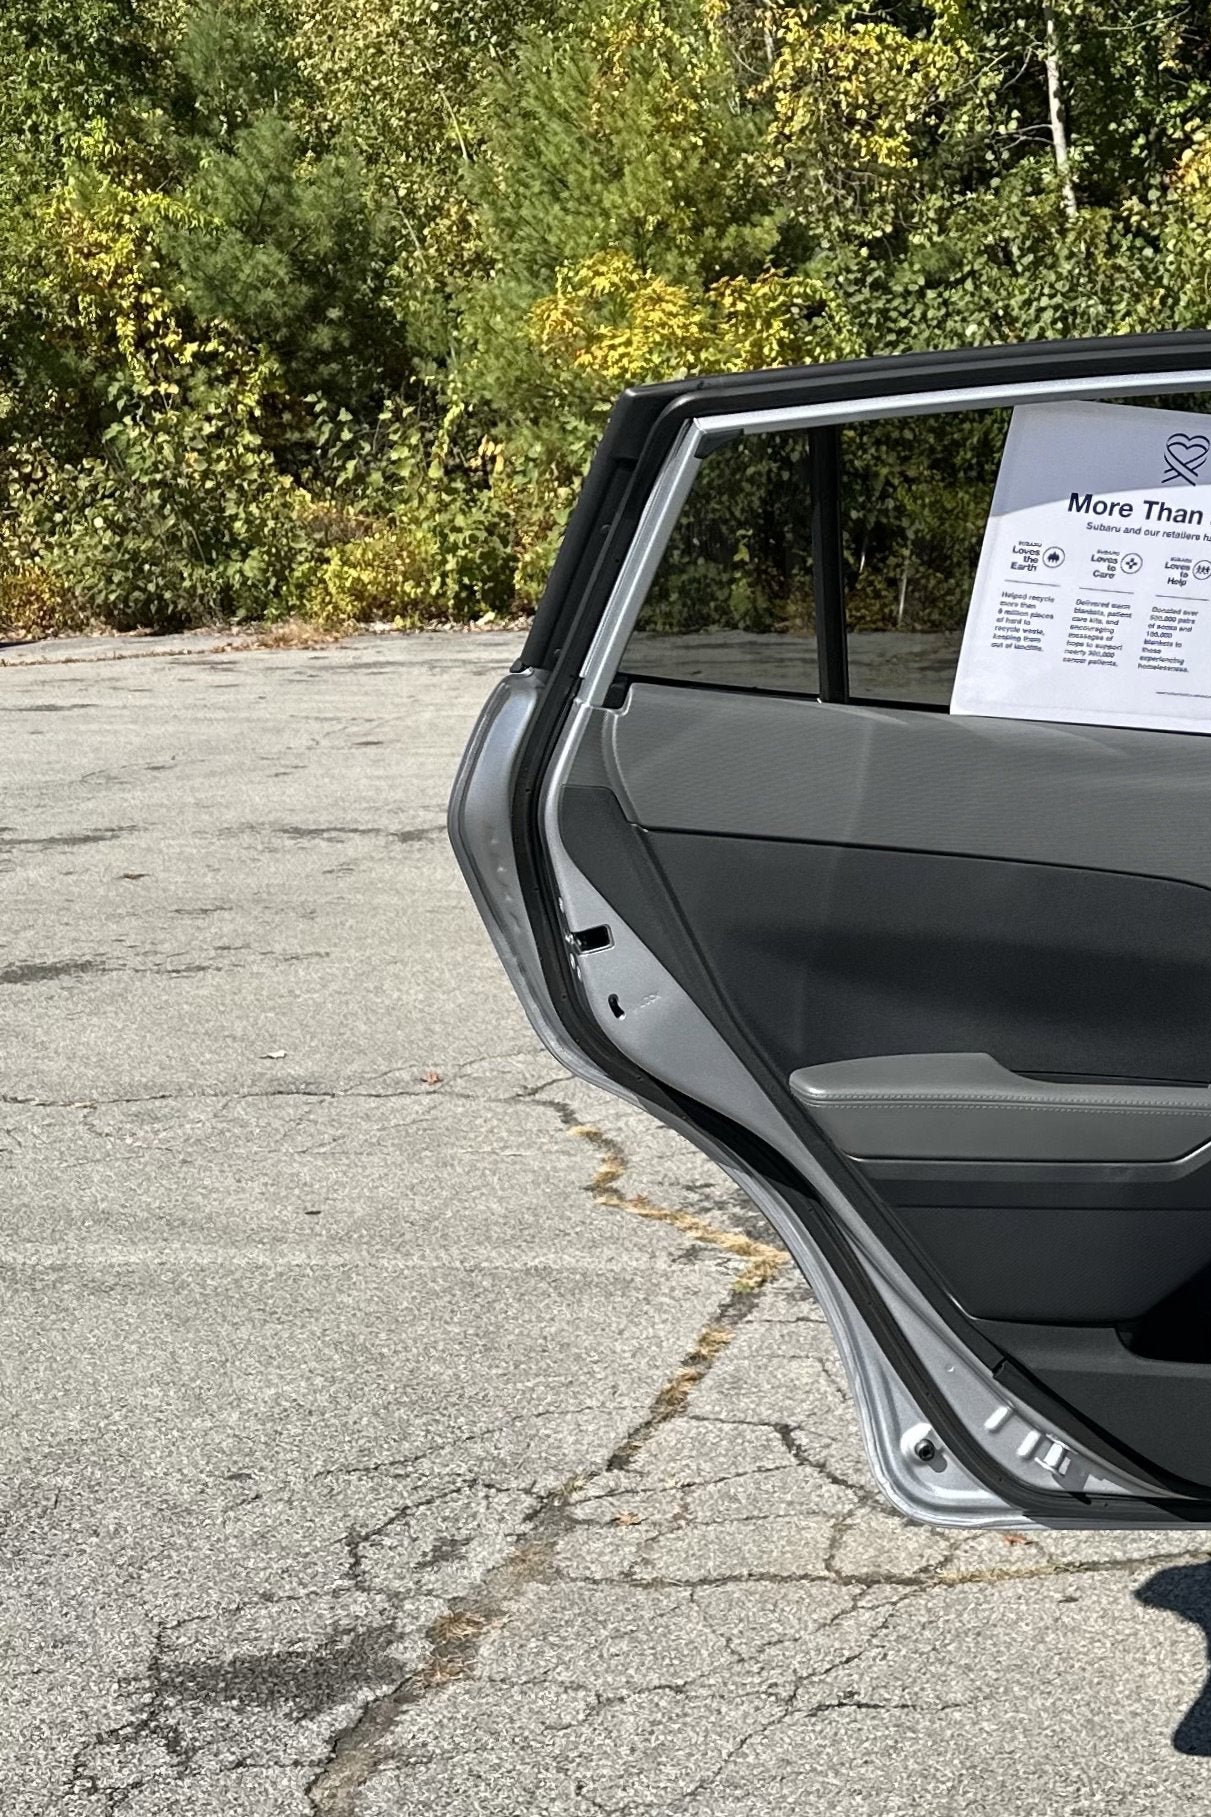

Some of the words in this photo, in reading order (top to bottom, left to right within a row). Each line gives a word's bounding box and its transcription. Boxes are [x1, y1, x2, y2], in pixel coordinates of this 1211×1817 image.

[1068, 492, 1134, 518] More
[1143, 500, 1203, 525] Than
[1086, 522, 1120, 533] Subaru
[1123, 524, 1141, 535] and
[1144, 528, 1160, 537] our
[1162, 529, 1200, 540] retailers
[1012, 546, 1040, 556] Loves
[1023, 555, 1039, 564] the
[1091, 554, 1118, 564] Loves
[1011, 562, 1037, 572] Earth
[1107, 564, 1116, 572] to
[1164, 562, 1191, 571] Loves
[1092, 570, 1116, 579] Care
[1180, 570, 1189, 578] to
[1167, 577, 1187, 587] Help
